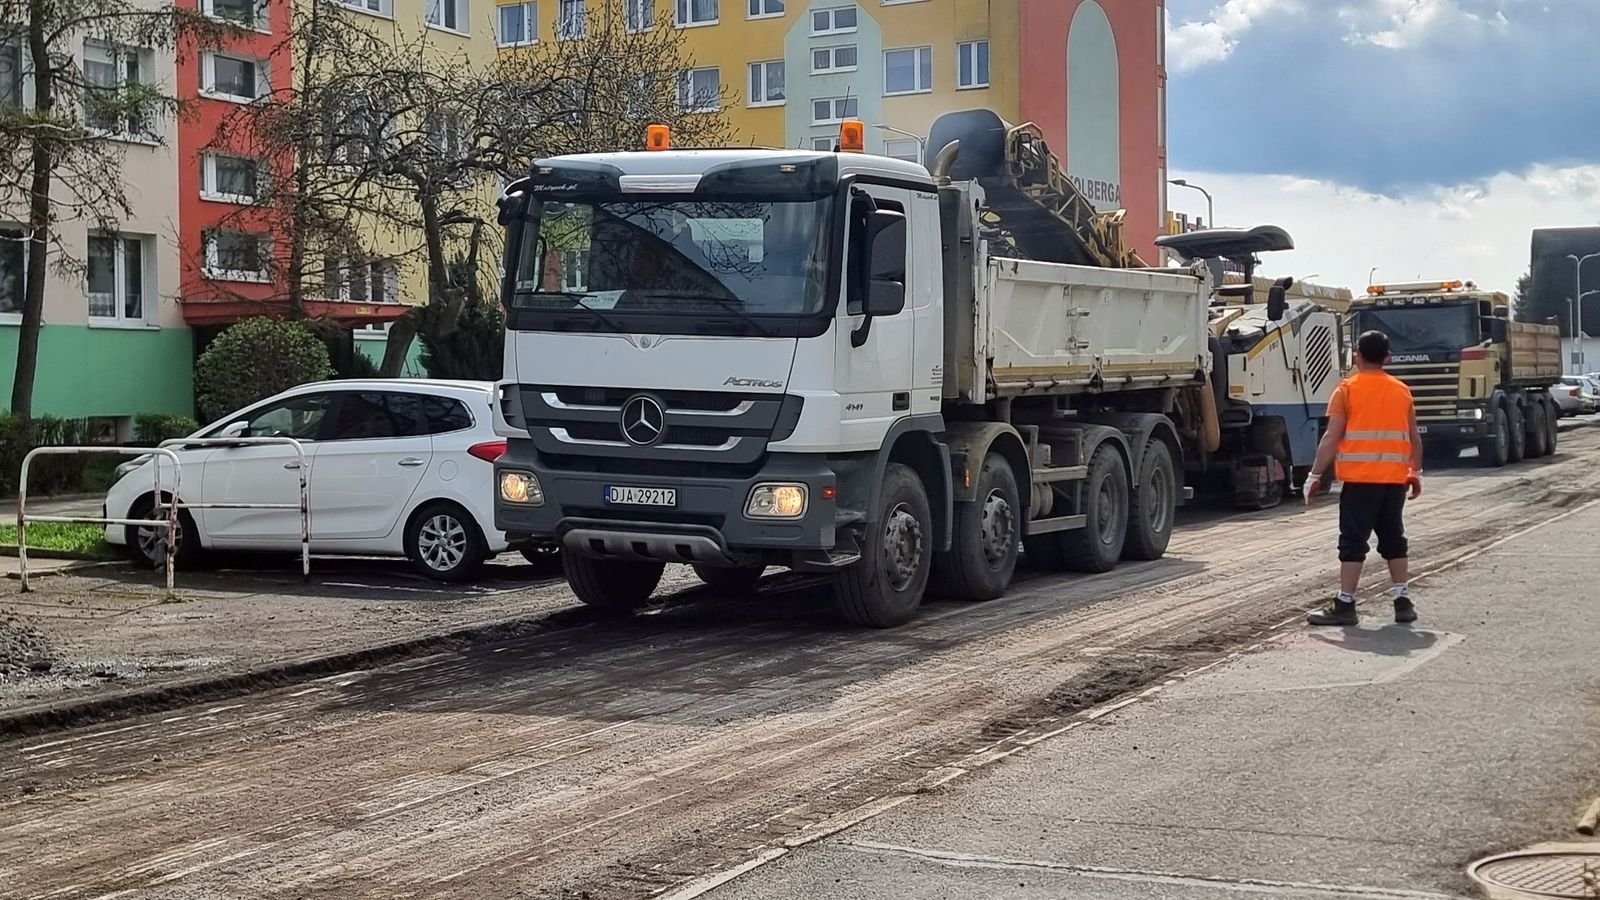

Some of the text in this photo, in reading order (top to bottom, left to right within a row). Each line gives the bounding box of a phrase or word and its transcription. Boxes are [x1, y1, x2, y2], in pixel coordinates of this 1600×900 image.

[1070, 175, 1121, 203] OLBERGA
[1391, 354, 1430, 363] SCANIA
[611, 488, 675, 504] DJA 29212
